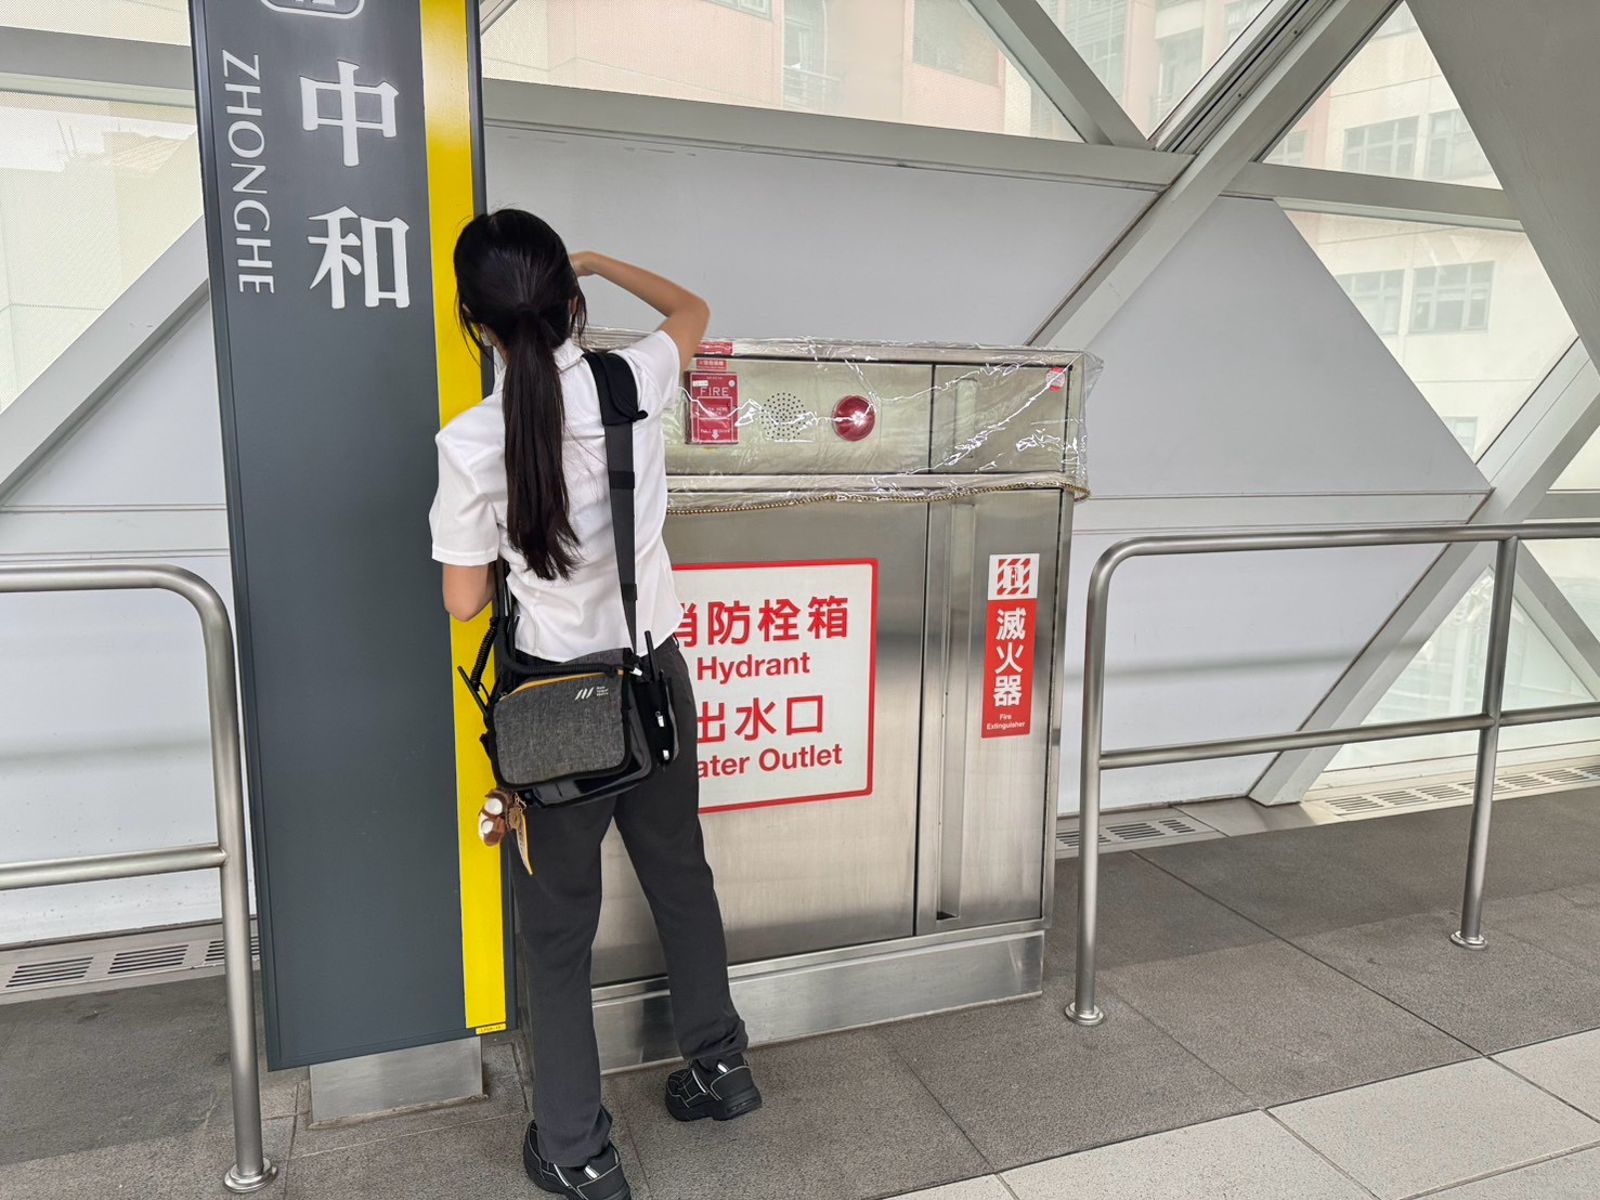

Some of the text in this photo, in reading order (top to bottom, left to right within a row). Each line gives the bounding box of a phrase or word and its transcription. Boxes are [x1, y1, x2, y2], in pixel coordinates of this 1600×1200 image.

[222, 50, 275, 294] ZHONGHE
[299, 60, 410, 309] 中和
[700, 387, 729, 397] FIRE
[697, 652, 811, 685] Hydrant
[993, 607, 1027, 708] 滅火器
[697, 695, 824, 744] 出水口
[986, 721, 1026, 731] Extinguisher
[999, 713, 1012, 721] Fire
[697, 743, 843, 778] ater Outlet
